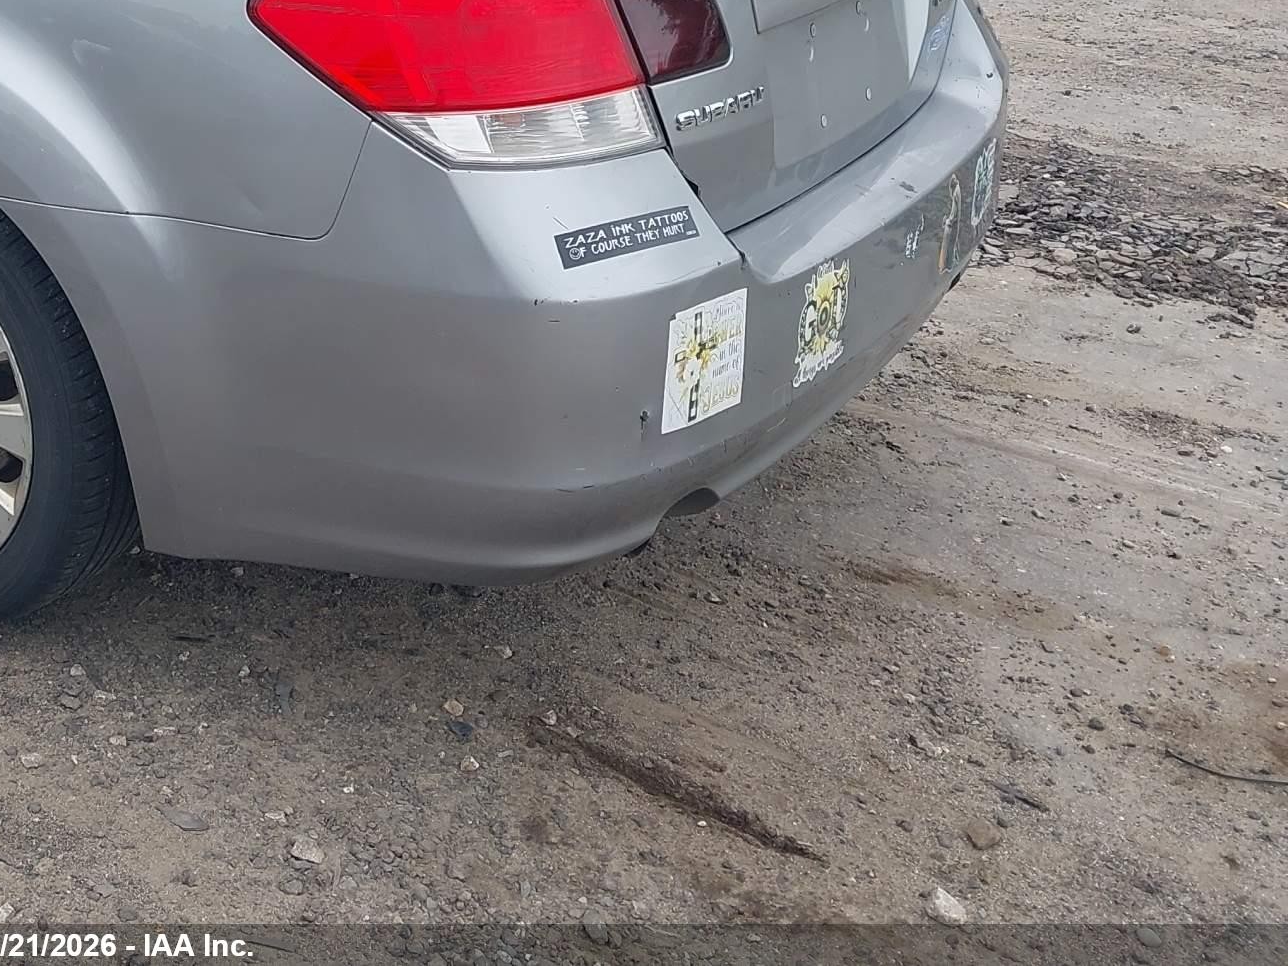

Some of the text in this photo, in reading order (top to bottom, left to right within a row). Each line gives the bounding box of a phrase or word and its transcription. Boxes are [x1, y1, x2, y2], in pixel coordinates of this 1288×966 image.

[563, 229, 607, 249] ZAZA
[637, 210, 689, 231] TATTOOS
[591, 235, 633, 254] COURSE
[634, 229, 660, 244] THEY
[662, 223, 685, 238] HURT
